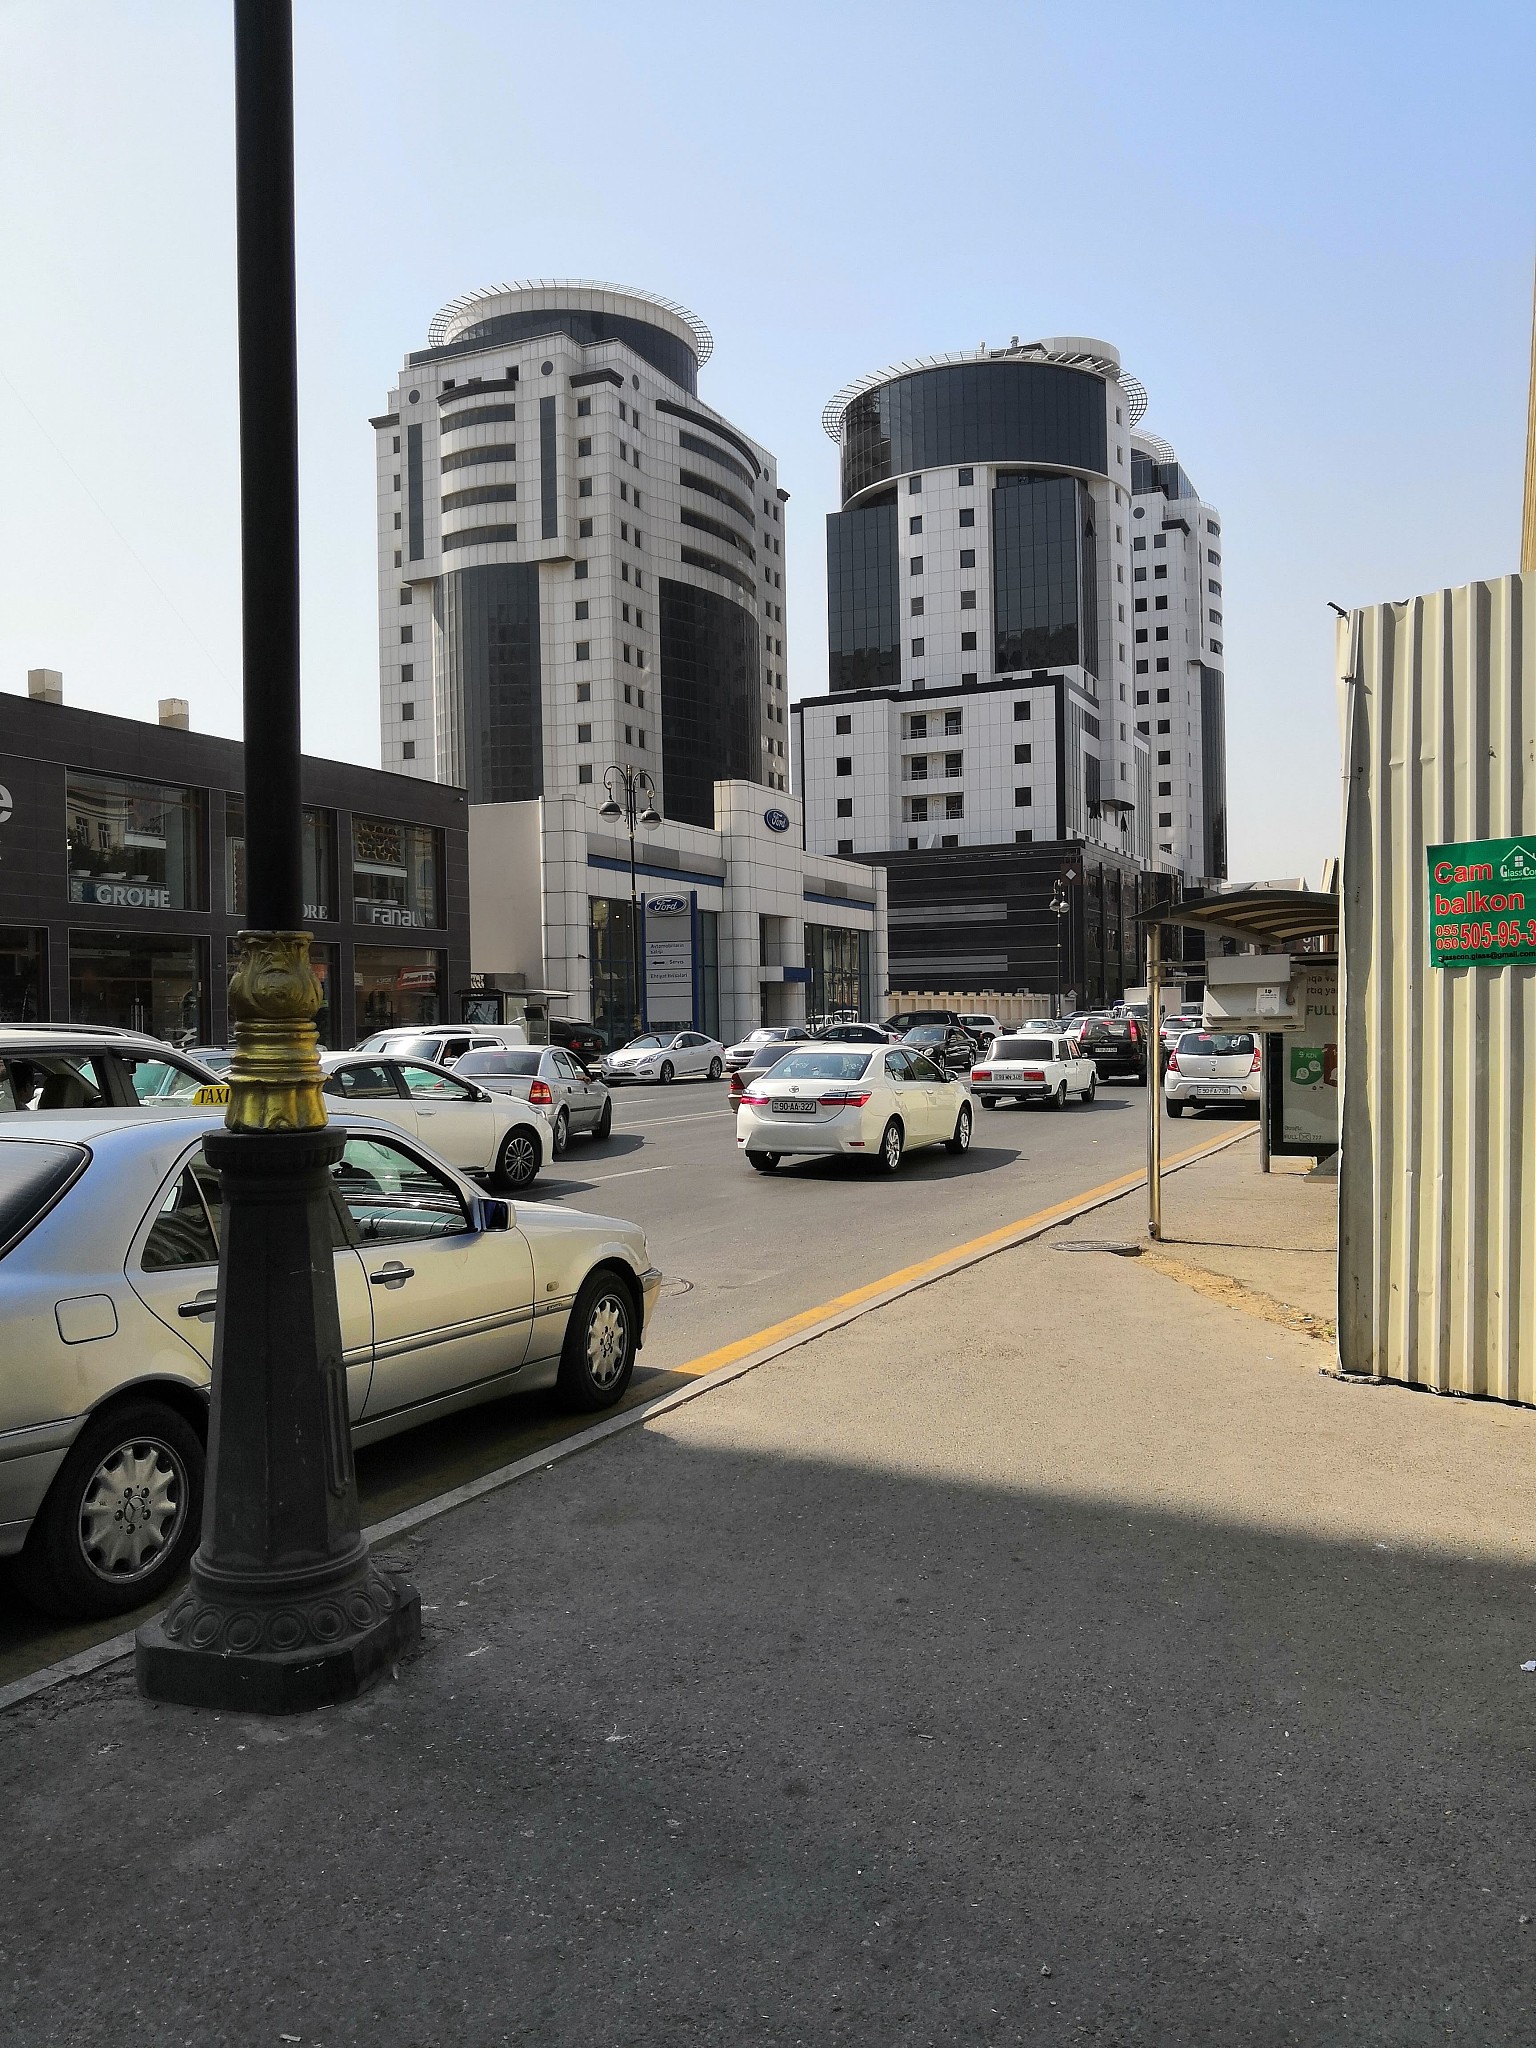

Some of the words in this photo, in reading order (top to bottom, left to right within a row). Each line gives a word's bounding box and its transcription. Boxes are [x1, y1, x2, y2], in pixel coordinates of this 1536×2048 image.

[1434, 862, 1493, 884] Cam
[1500, 865, 1536, 877] GlassCo
[96, 885, 170, 908] GROHE
[1435, 891, 1525, 915] balkon
[1436, 924, 1458, 937] 055
[1436, 938, 1458, 950] 050
[198, 1088, 231, 1104] TAXI
[779, 1103, 814, 1111] 90-AA-327
